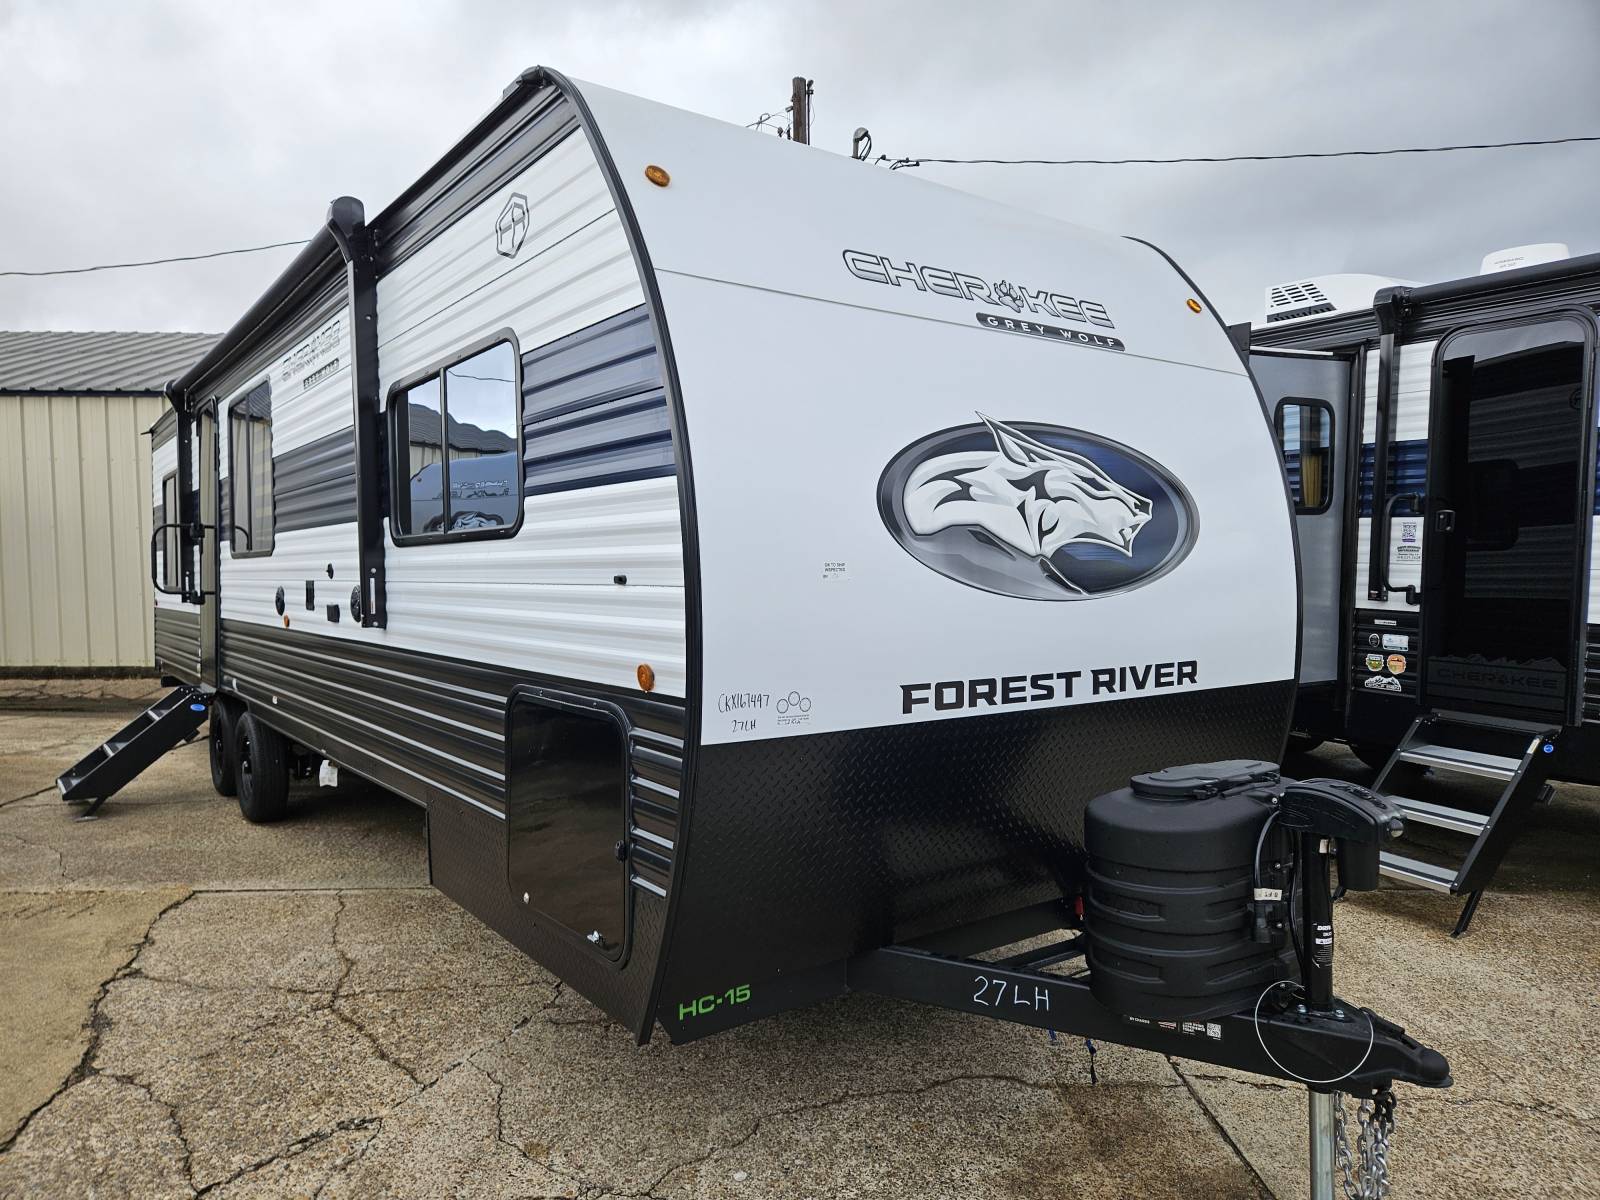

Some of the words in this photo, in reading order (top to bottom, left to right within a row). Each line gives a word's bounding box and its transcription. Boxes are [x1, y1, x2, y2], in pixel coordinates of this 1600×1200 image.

[986, 315, 1045, 336] GREY
[1059, 328, 1115, 348] WOLF
[900, 670, 1082, 715] FOREST
[1090, 659, 1199, 697] RIVER
[678, 983, 752, 1021] HC-15
[972, 975, 1050, 1013] 27LH
